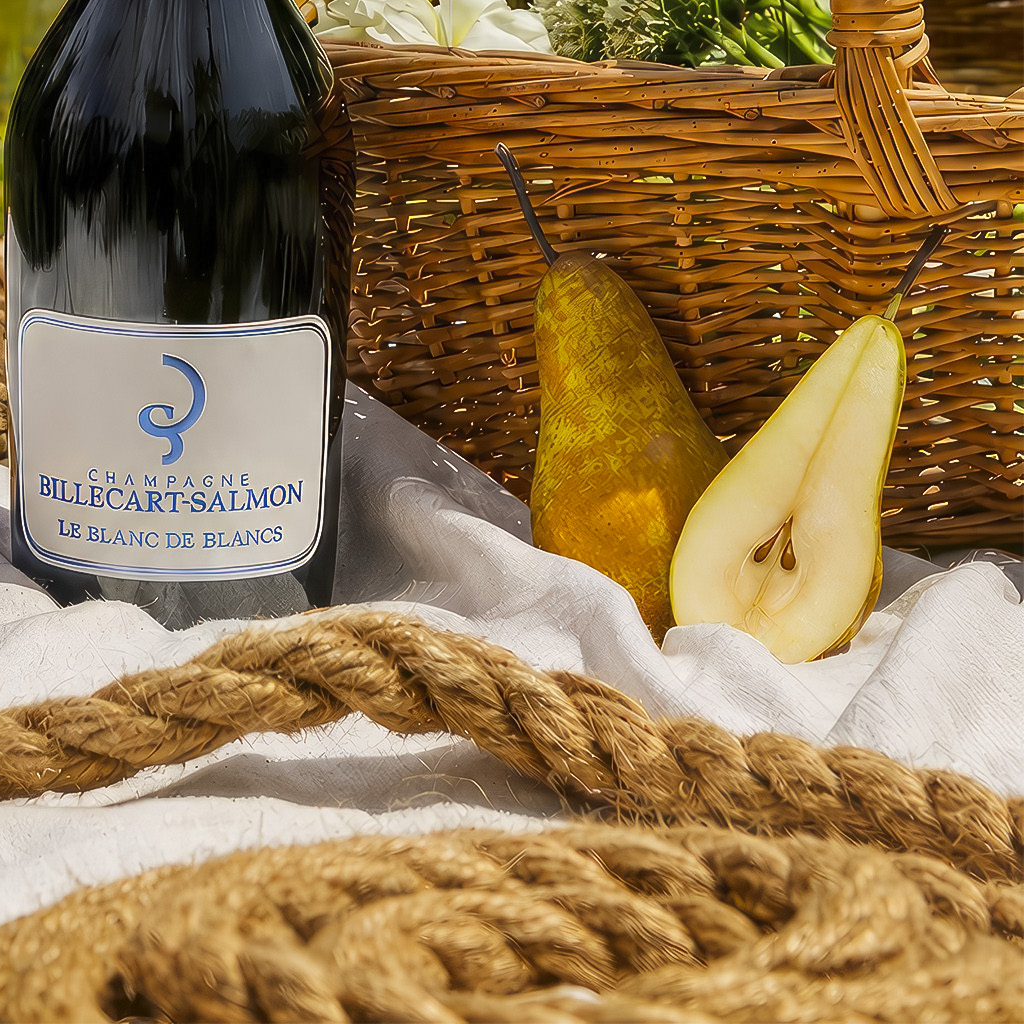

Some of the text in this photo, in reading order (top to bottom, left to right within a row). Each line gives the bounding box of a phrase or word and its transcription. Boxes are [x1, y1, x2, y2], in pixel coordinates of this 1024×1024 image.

[38, 473, 304, 514] BILLECART-SALMON
[88, 468, 251, 489] CHAMPAGNE
[57, 518, 284, 549] LE BLANC DE BLANCS
